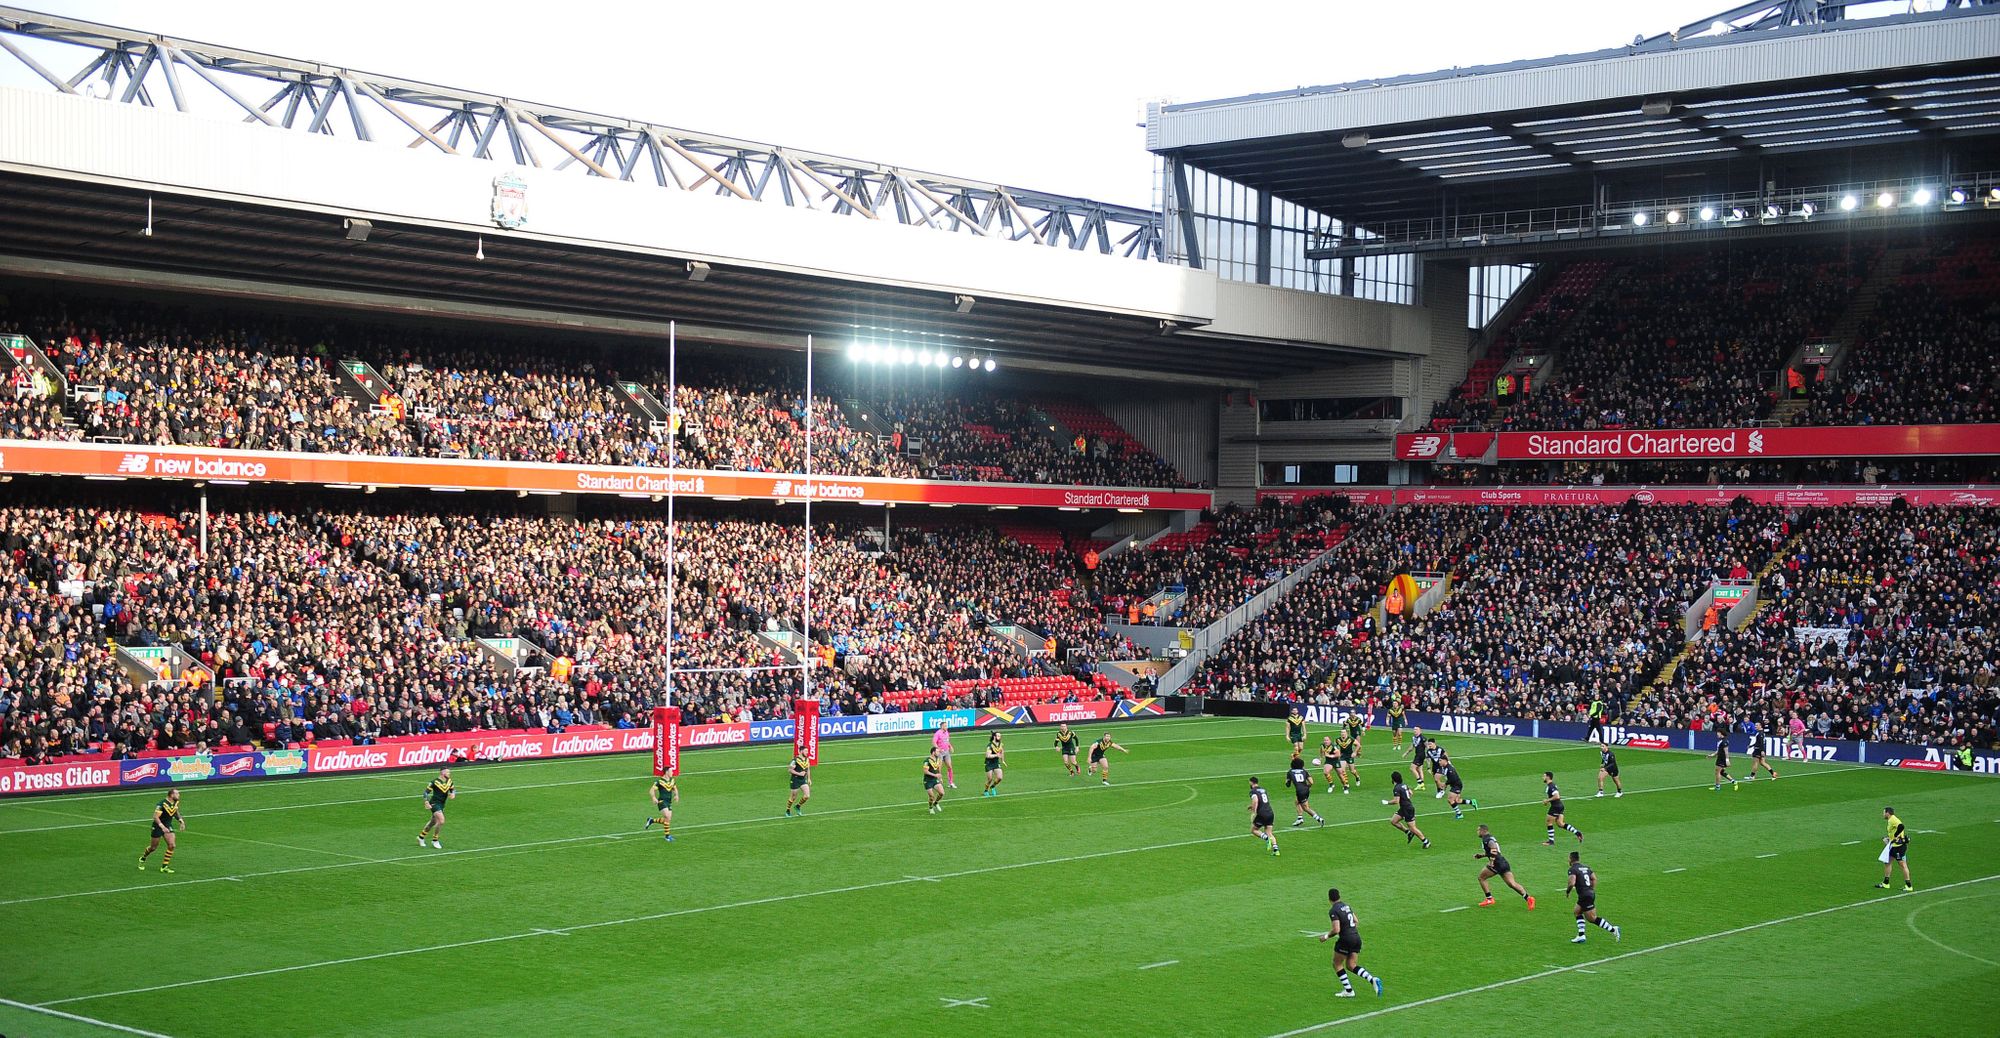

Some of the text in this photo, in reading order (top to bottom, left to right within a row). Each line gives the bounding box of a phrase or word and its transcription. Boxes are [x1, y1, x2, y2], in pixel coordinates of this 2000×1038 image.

[1528, 432, 1735, 455] Standard Chartered
[155, 457, 266, 476] new balance
[577, 473, 694, 491] Standard Chartered
[794, 483, 864, 498] new balance
[1481, 492, 1521, 502] Club Sports
[1544, 493, 1598, 501] PRAETURA
[1064, 492, 1144, 506] Standard Chartered
[1050, 711, 1097, 721] FOUR NATIONS
[762, 725, 794, 739] DAC
[820, 722, 866, 736] DACIA
[875, 718, 916, 732] trainline
[1440, 715, 1515, 736] Allianz
[690, 727, 746, 745] Ladbrokes
[809, 714, 817, 760] Ladbrokes
[552, 735, 614, 754] Ladbrokes
[656, 723, 664, 771] Ladbrokes
[669, 723, 677, 770] Ladbrokes
[314, 749, 388, 771] Ladbrokes
[1884, 758, 1900, 766] 20
[14, 771, 63, 790] Press
[66, 767, 110, 786] Cider
[1295, 773, 1305, 783] 10
[1348, 913, 1355, 928] 2
